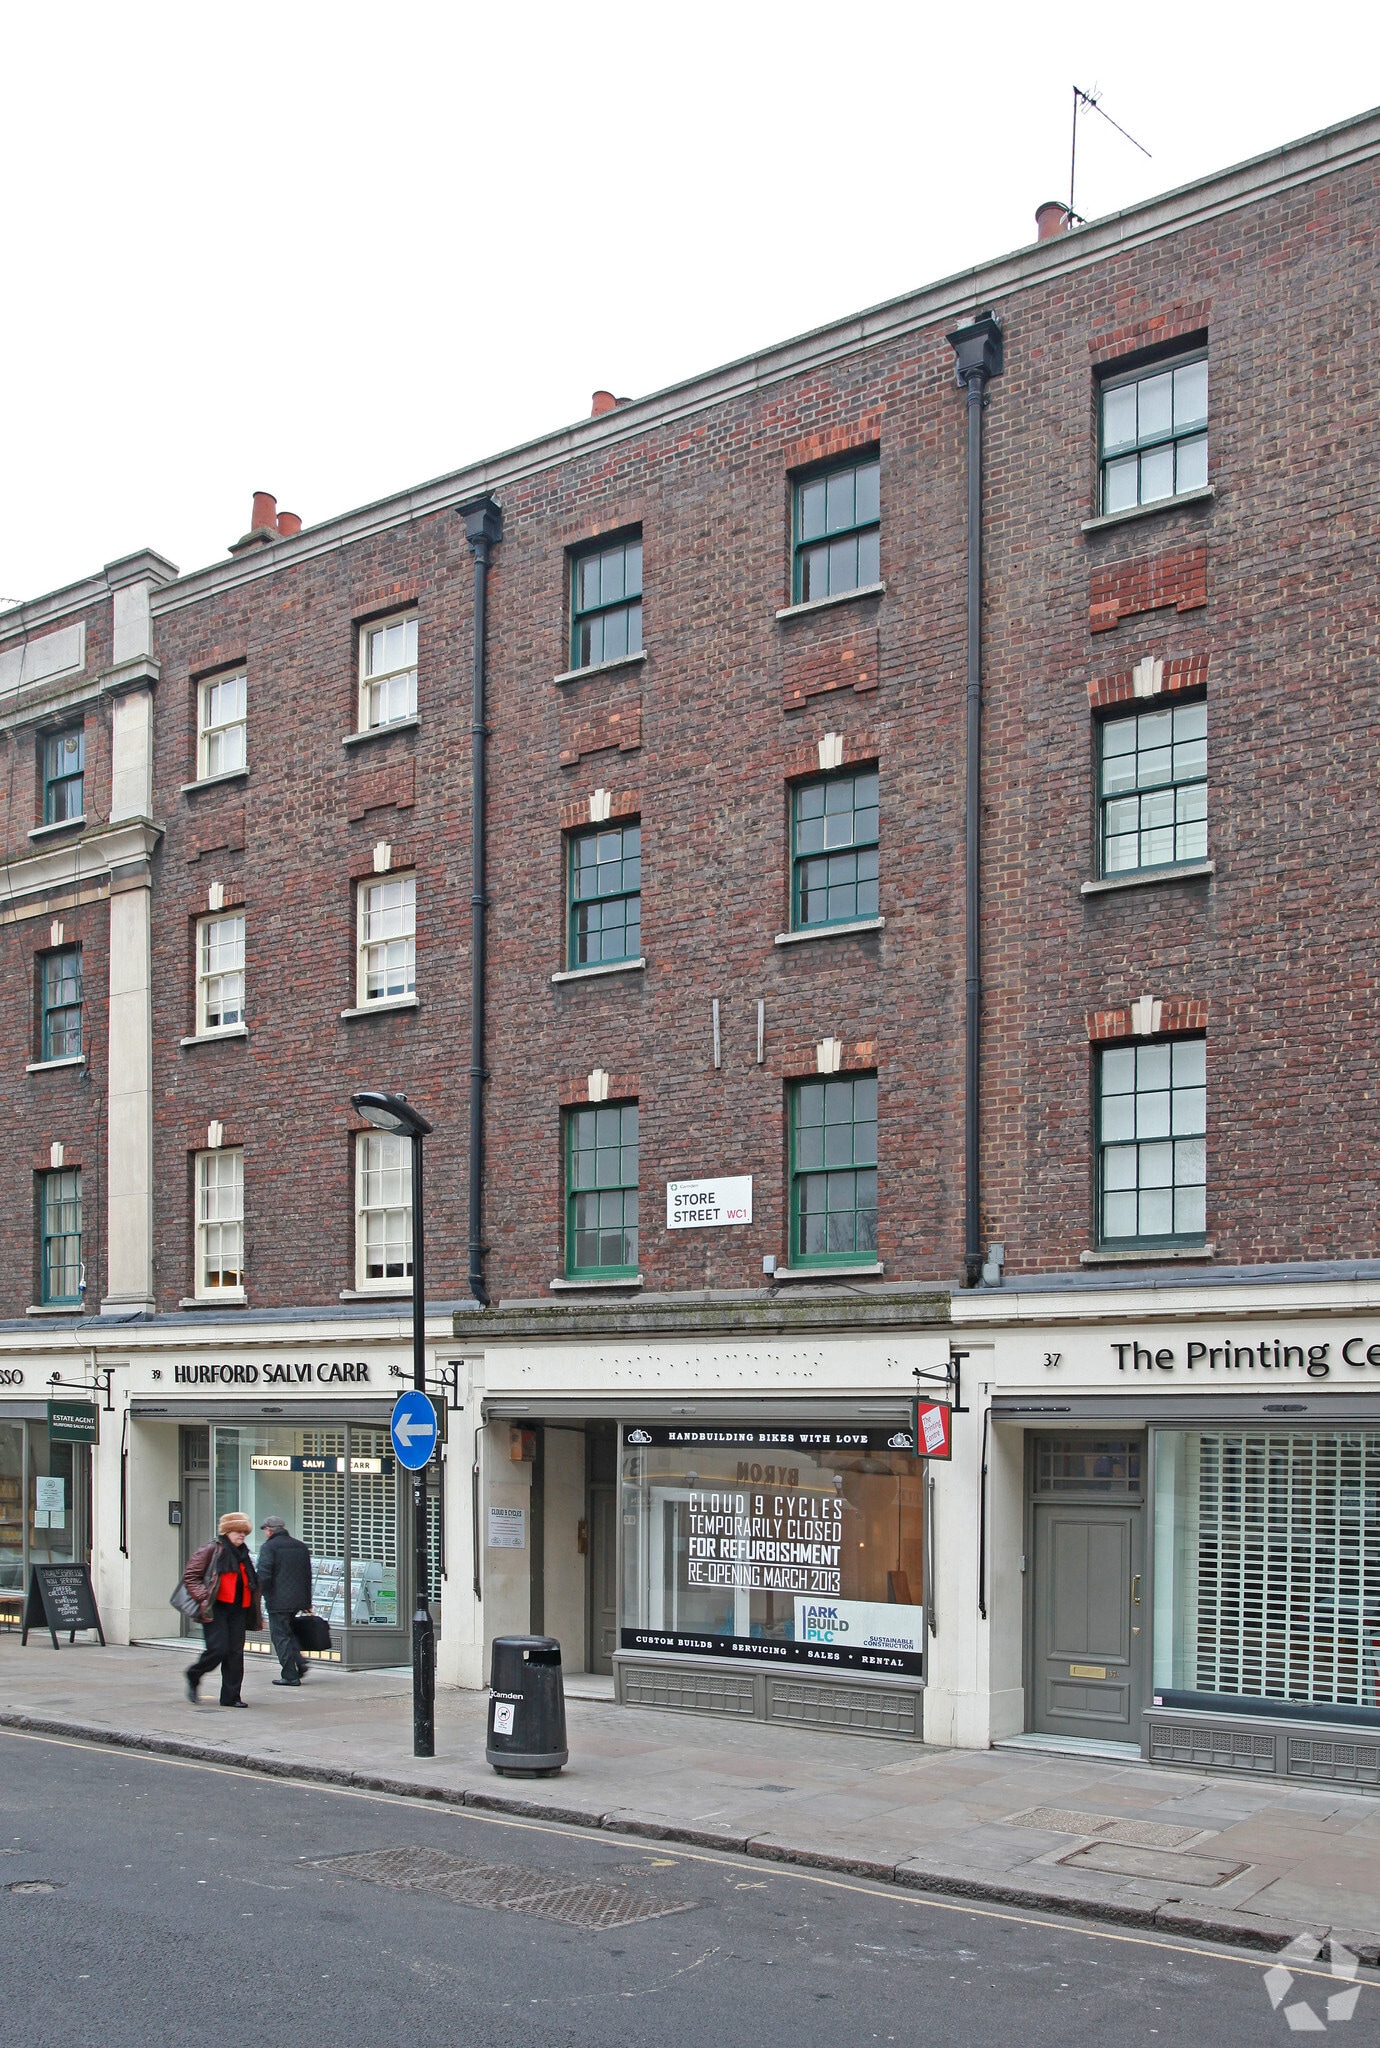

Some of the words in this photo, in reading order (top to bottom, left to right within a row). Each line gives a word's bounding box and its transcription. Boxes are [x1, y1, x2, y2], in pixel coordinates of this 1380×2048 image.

[674, 1192, 715, 1206] STORE
[674, 1208, 720, 1222] STREET
[727, 1208, 747, 1219] WC1
[1043, 1353, 1061, 1367] 37
[1110, 1341, 1175, 1370] The
[1186, 1339, 1330, 1378] Printing
[1342, 1337, 1380, 1367] Ce
[51, 1371, 61, 1381] 40
[151, 1369, 161, 1380] 39
[174, 1364, 259, 1384] HURFORD
[263, 1363, 312, 1383] SALVI
[317, 1362, 370, 1382] CARR
[387, 1365, 399, 1376] 39
[53, 1414, 74, 1422] ESTATE
[923, 1416, 931, 1425] The
[924, 1420, 941, 1433] Printing
[668, 1432, 754, 1442] HANDBUILDING
[758, 1433, 795, 1442] BIKES
[799, 1434, 831, 1443] WITH
[836, 1435, 868, 1444] LOVE
[252, 1459, 289, 1467] HURFORD
[302, 1460, 325, 1468] SALVI
[491, 1508, 504, 1516] CLOUD
[508, 1509, 522, 1517] CYCLES
[689, 1493, 744, 1515] CLOUD
[755, 1495, 764, 1515] 9
[774, 1496, 843, 1520] CYCLES
[689, 1514, 782, 1539] TEMPORARILY
[787, 1519, 842, 1542] CLOSED
[689, 1537, 716, 1558] FOR
[720, 1538, 841, 1566] REFURBISHMENT
[688, 1562, 760, 1586] RE-OPENING
[763, 1567, 807, 1590] MARCH
[811, 1570, 841, 1592] 2013
[807, 1605, 838, 1619] ARK
[807, 1617, 850, 1632] BUILD
[807, 1629, 834, 1643] PLC
[869, 1635, 914, 1644] SUSTAINABLE
[635, 1635, 674, 1646] CUSTOM
[678, 1638, 713, 1649] BUILDS
[732, 1643, 787, 1655] SERVICING
[807, 1650, 840, 1660] SALES
[861, 1655, 904, 1667] RENTAL
[863, 1640, 914, 1650] CONSTRUCTION
[492, 1690, 524, 1700] Camden
